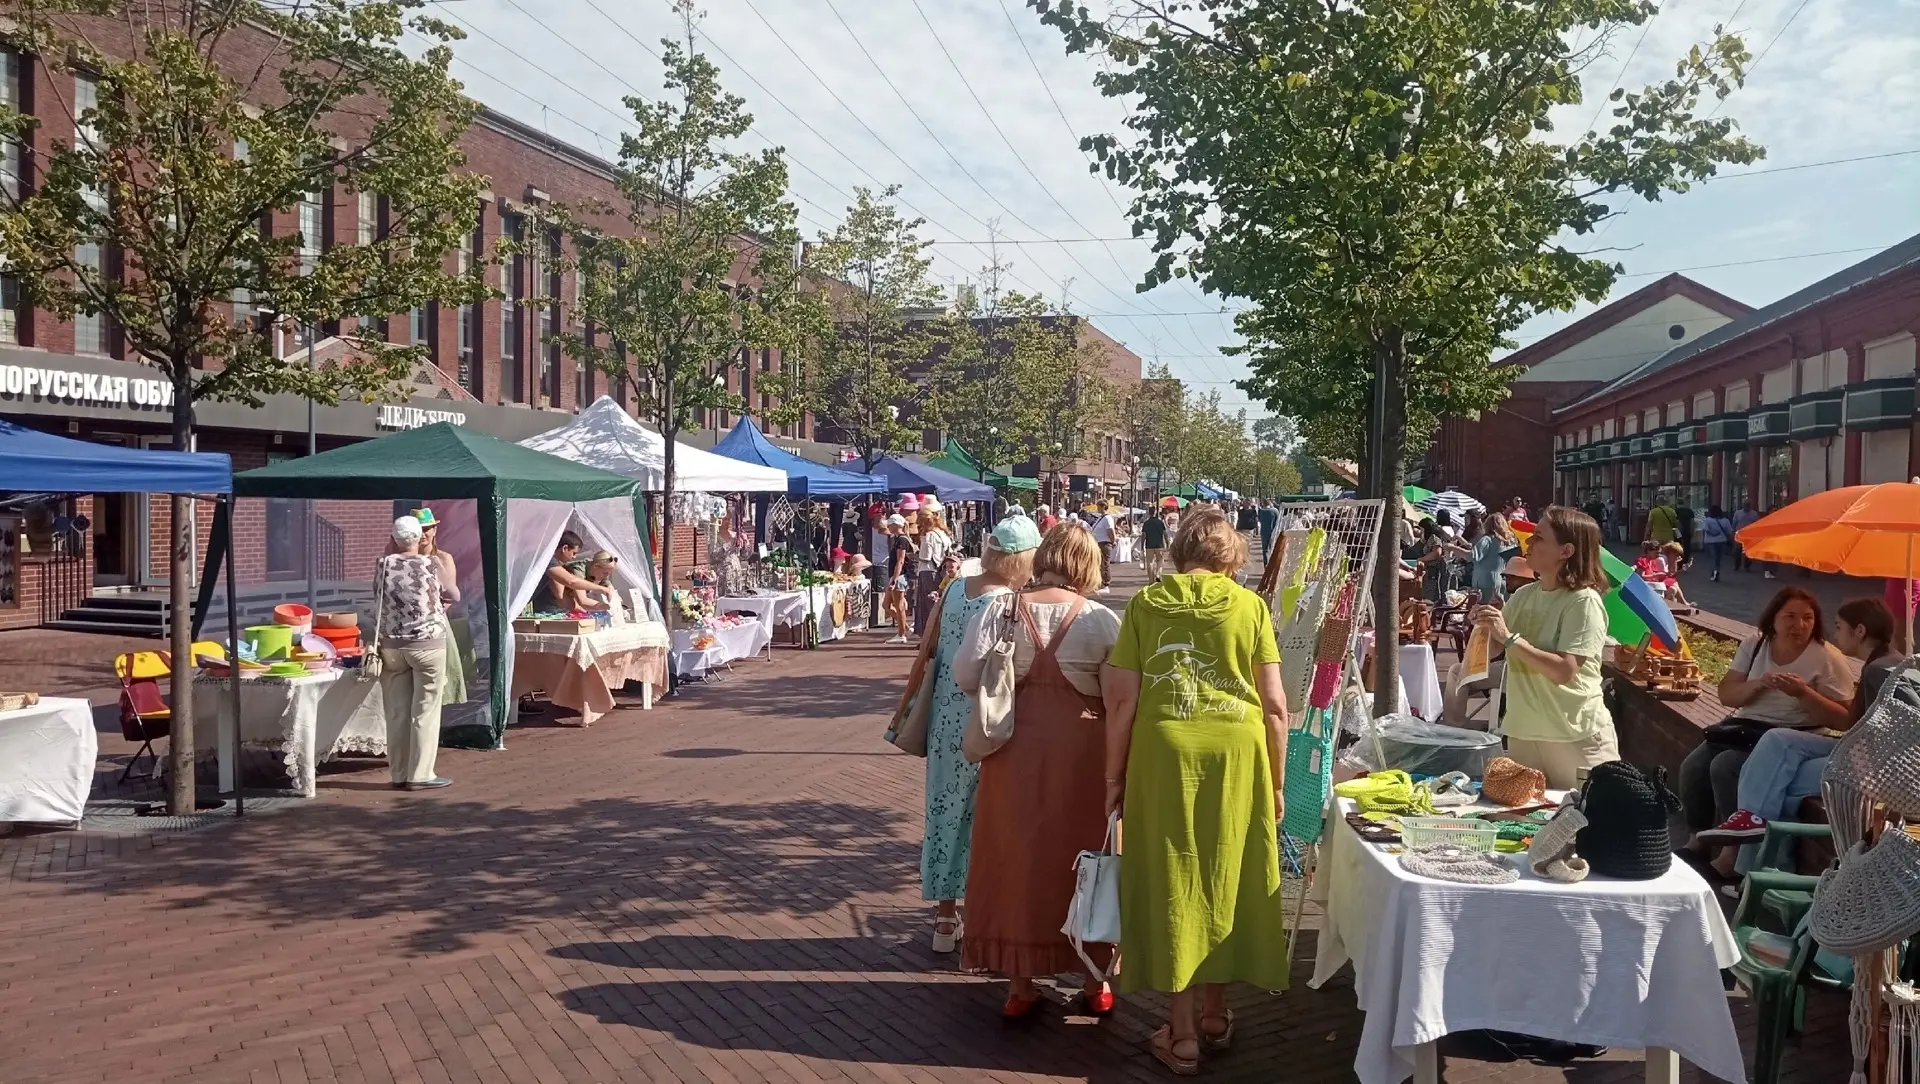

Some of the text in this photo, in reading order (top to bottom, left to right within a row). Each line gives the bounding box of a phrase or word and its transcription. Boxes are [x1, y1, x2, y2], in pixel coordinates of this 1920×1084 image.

[134, 378, 174, 406] ОБУ
[1202, 669, 1249, 701] Beauty
[1201, 692, 1247, 721] Lady
